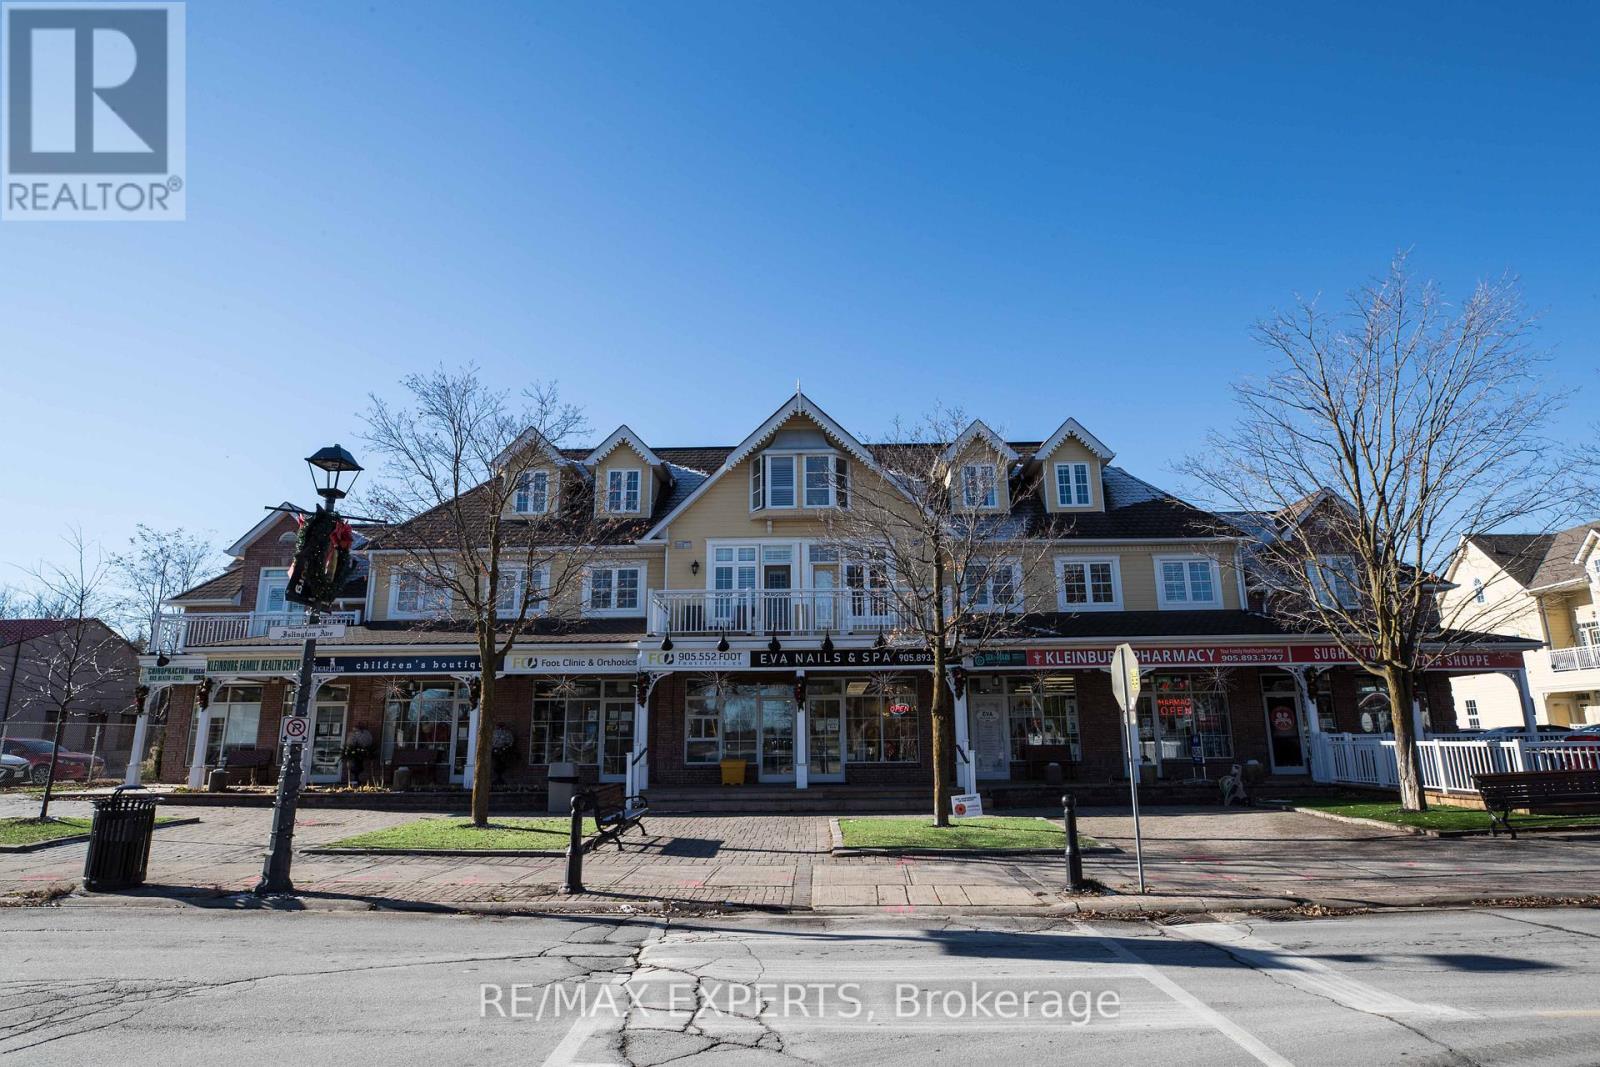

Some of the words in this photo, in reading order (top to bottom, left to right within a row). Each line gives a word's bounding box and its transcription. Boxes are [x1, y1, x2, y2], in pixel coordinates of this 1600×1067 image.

[541, 658, 560, 667] Foot
[562, 658, 586, 667] Clinic
[588, 658, 594, 667] &
[597, 658, 638, 667] Orthotics
[760, 653, 788, 664] EVA
[795, 652, 841, 663] NAILS
[847, 652, 856, 663] &
[863, 652, 891, 663] SPA
[1045, 650, 1115, 664] KLEINBUR
[1221, 654, 1284, 662] 905.893.3747
[1446, 654, 1490, 666] SHOPPE
[207, 660, 239, 671] KLEINBURG
[239, 659, 260, 671] FAMILY
[260, 659, 282, 671] HEALTH
[356, 659, 426, 670] children's
[433, 660, 483, 671] boutiqu
[1160, 706, 1192, 716] OPEN
